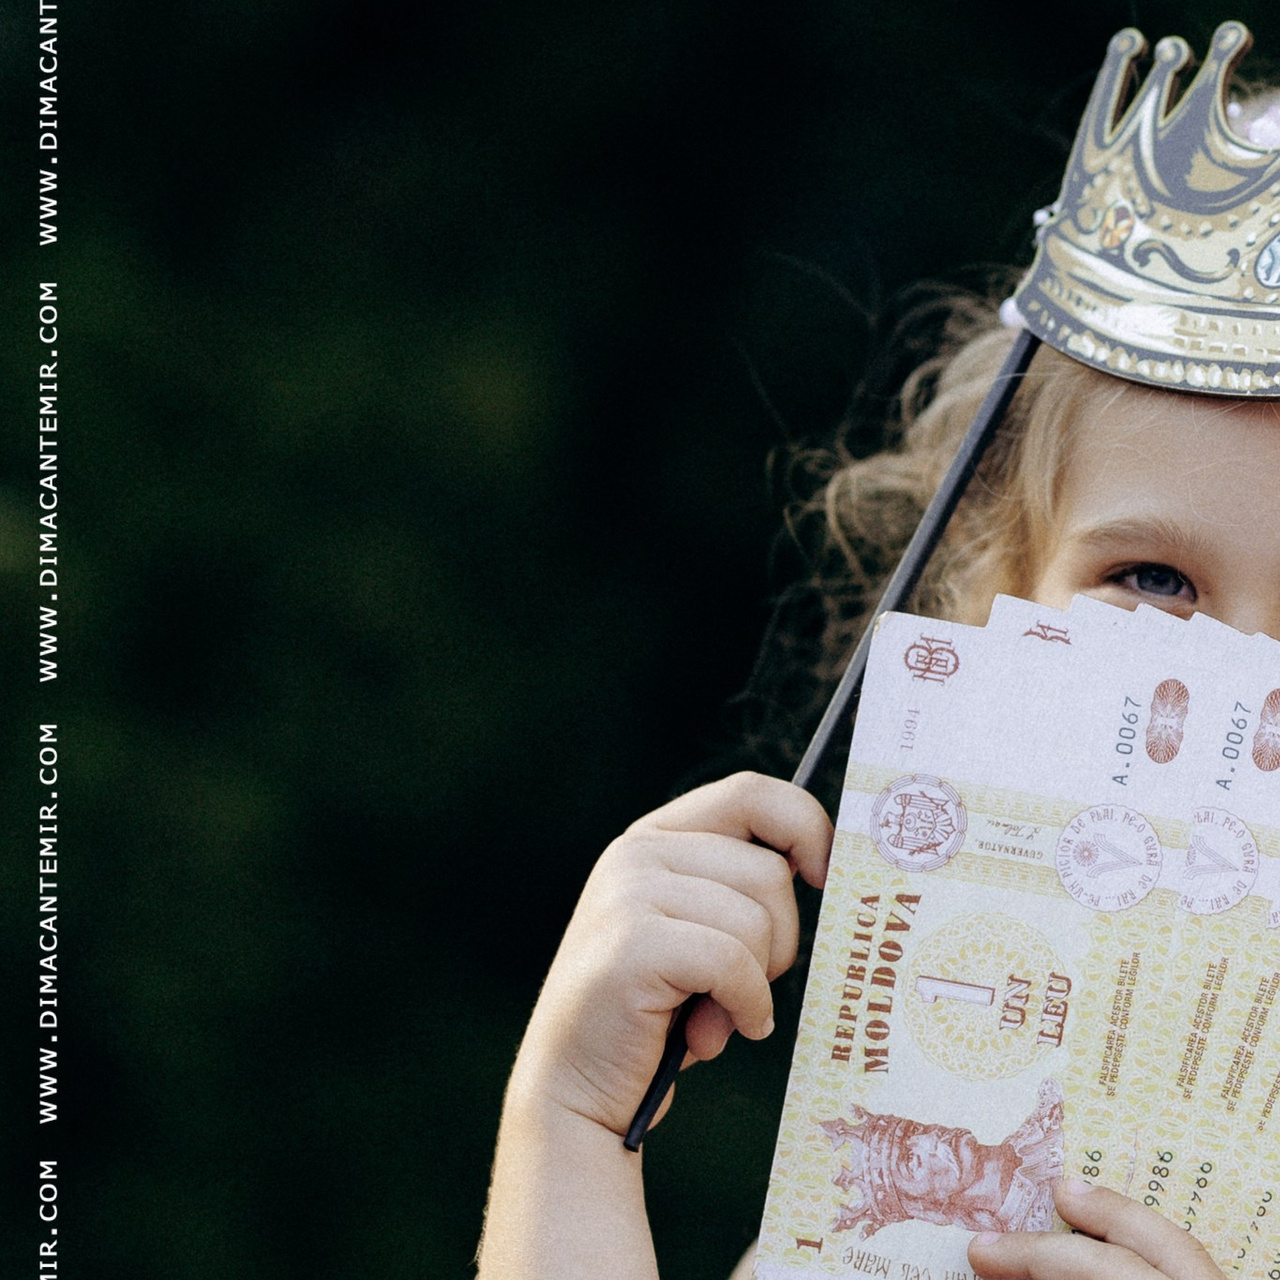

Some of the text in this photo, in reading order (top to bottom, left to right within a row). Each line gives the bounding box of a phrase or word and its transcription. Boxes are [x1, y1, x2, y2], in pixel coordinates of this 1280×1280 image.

[901, 708, 920, 751] 1994
[1112, 696, 1142, 786] A.0067
[1216, 701, 1252, 791] A.0067
[831, 895, 881, 1062] REPUBLICA
[864, 894, 922, 1073] MOLDOVA
[915, 975, 995, 1006] 1
[999, 974, 1032, 1031] UN
[1037, 972, 1073, 1048] LEU
[1098, 958, 1129, 1085] FALSIFICAREA ACESTOR BILETE
[1106, 1085, 1116, 1096] SE
[1118, 988, 1133, 1030] CONFORM
[1127, 951, 1140, 986] LEGILOR
[1176, 962, 1216, 1087] FALSIFICAREA ACESTOR BILETE
[1183, 1087, 1193, 1099] SE
[1200, 992, 1219, 1034] CONFORM
[1212, 956, 1229, 990] LEGILOR
[1220, 976, 1269, 1099] FALSIFICAREA ACESTOR BILETE
[1227, 1099, 1237, 1111] SE
[1249, 1006, 1270, 1047] CONFORM
[795, 1237, 823, 1254] 1
